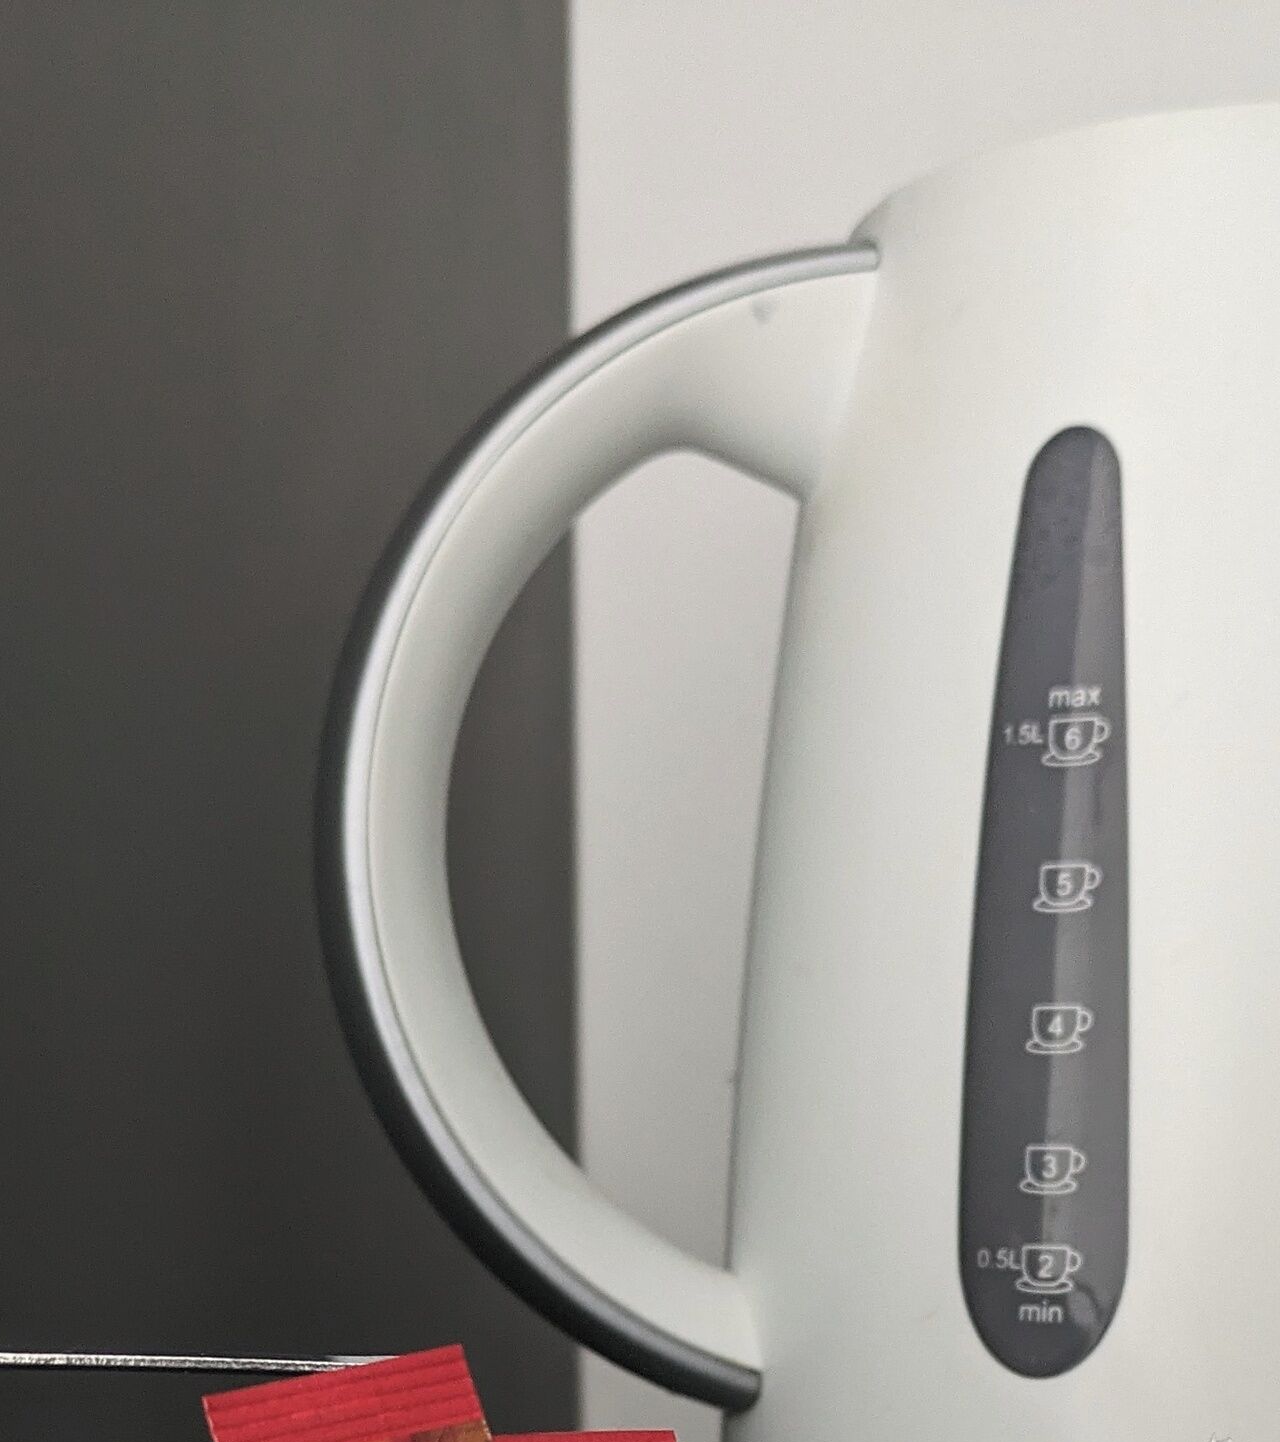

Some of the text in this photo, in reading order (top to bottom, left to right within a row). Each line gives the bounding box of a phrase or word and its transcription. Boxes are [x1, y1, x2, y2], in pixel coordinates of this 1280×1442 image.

[1048, 686, 1102, 708] max
[1064, 726, 1081, 751] 6
[1057, 871, 1074, 897] 5
[1047, 1014, 1063, 1036] 4
[1041, 1156, 1058, 1179] 3
[1038, 1255, 1054, 1279] 2
[1019, 1299, 1063, 1322] min
